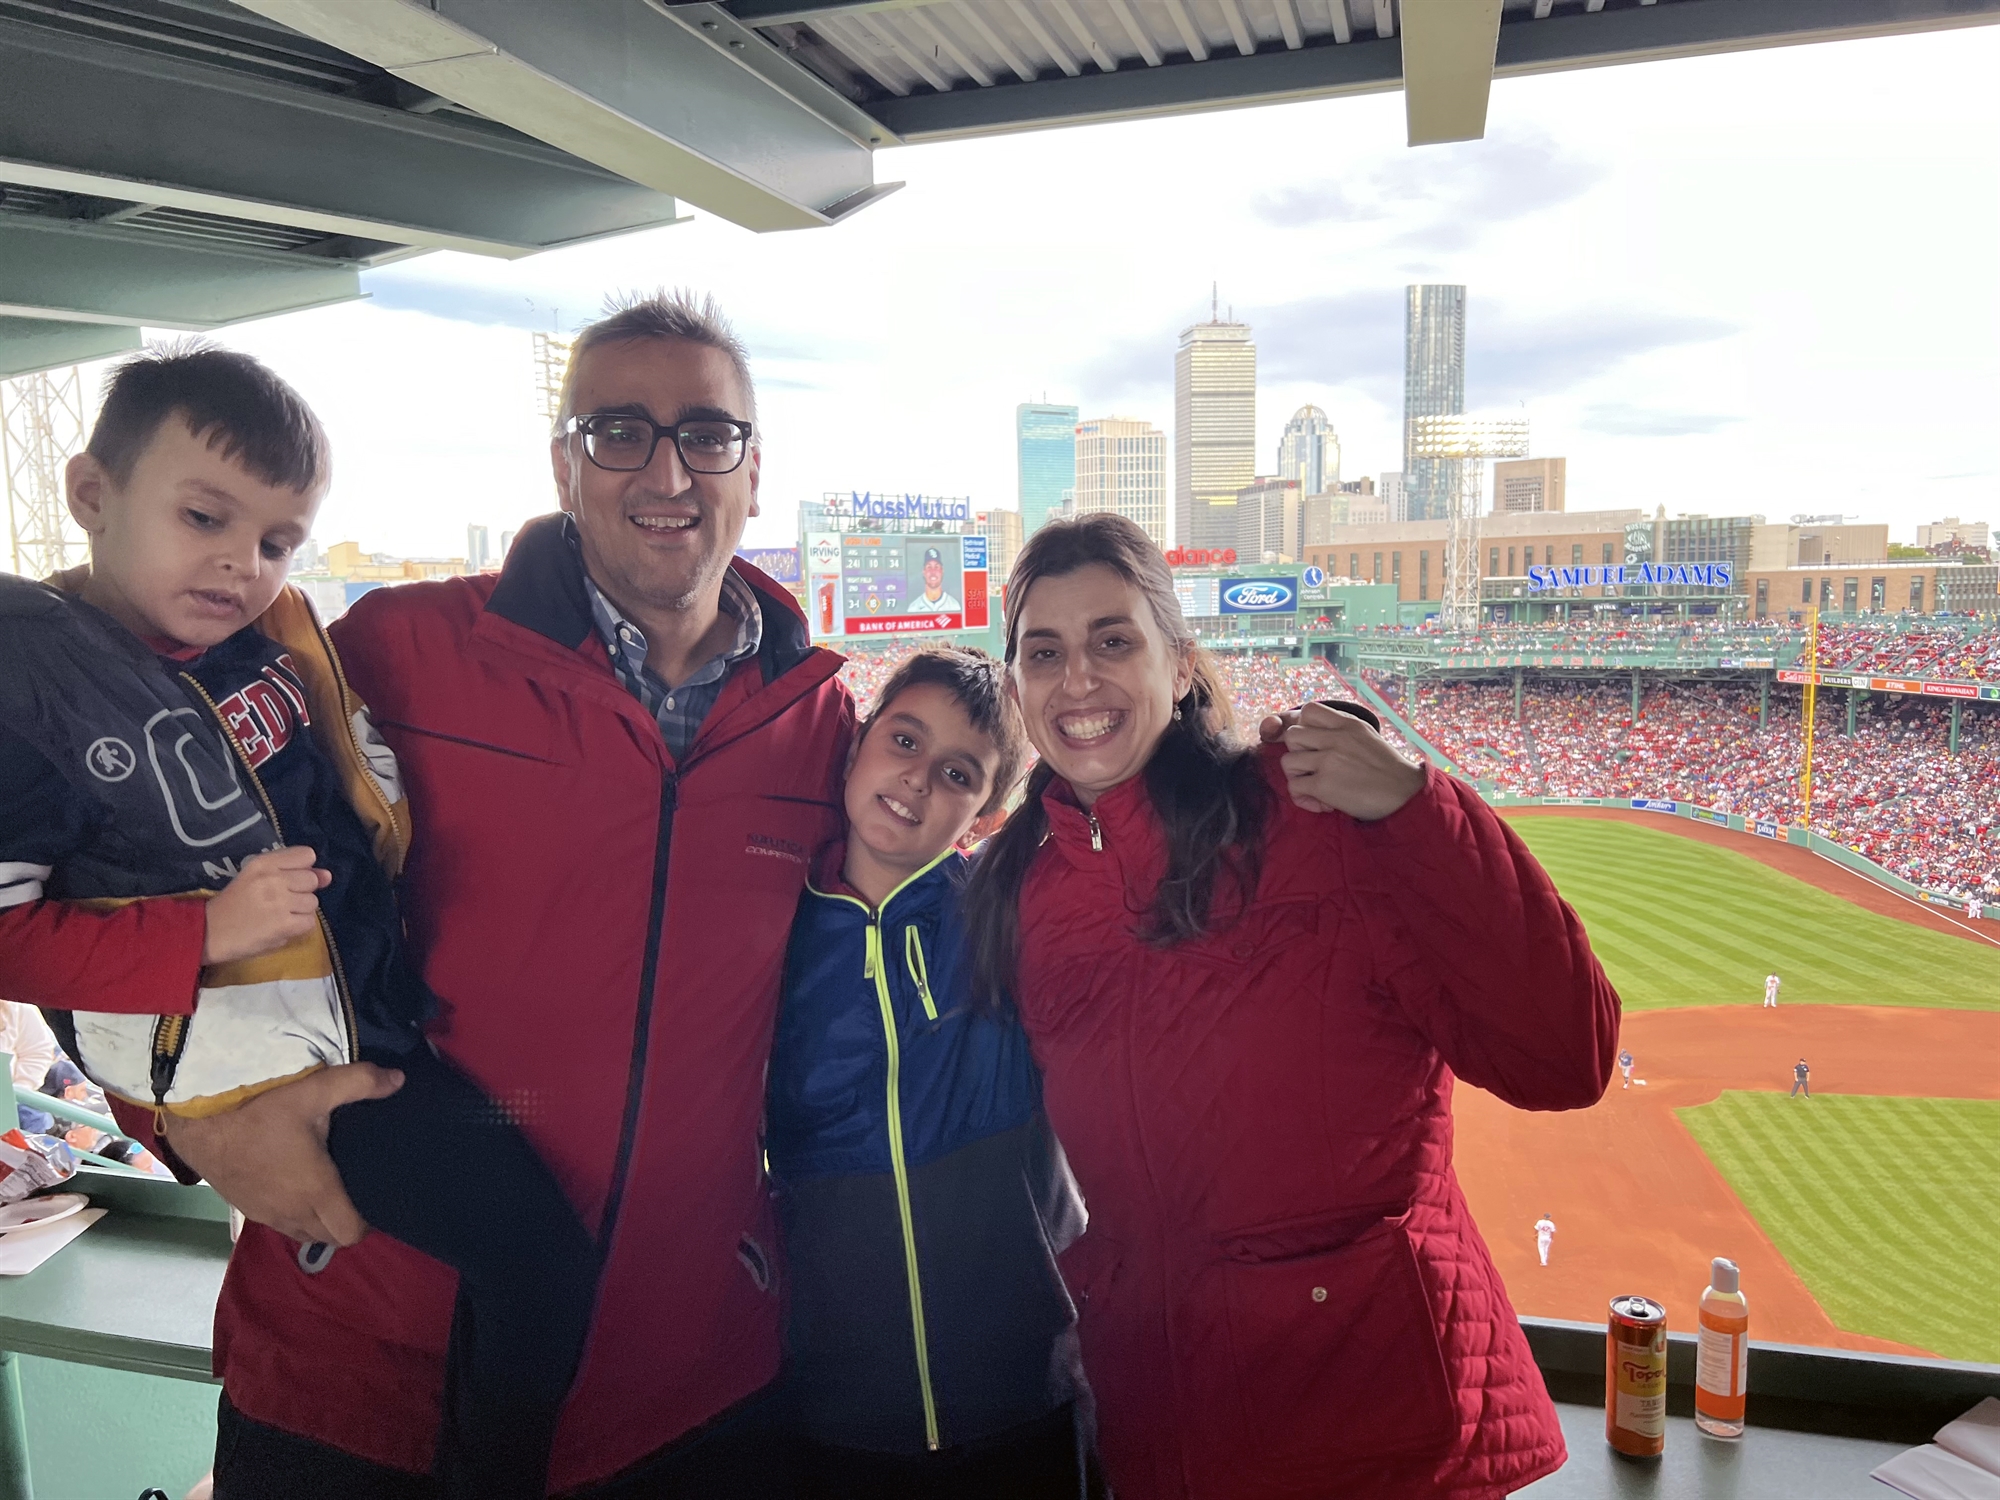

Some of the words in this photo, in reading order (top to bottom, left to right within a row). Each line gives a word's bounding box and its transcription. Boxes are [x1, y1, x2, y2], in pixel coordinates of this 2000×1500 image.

[852, 490, 970, 520] MassMutual
[809, 547, 840, 557] IRVING
[1164, 545, 1237, 567] alance
[869, 559, 879, 568] 10
[889, 559, 899, 568] 34
[1528, 564, 1631, 592] SAMUEL
[1634, 561, 1730, 588] ADAMS
[1237, 586, 1278, 605] Ford
[859, 622, 884, 632] BANK
[884, 621, 896, 631] OF
[897, 619, 935, 630] AMERICA
[1798, 673, 1815, 685] PIZZ
[1824, 676, 1852, 685] BUILDERS
[1853, 678, 1866, 687] GIN
[1885, 681, 1906, 690] STIHL
[1945, 686, 1976, 696] HAWAIIAN
[1493, 792, 1505, 800] 380
[744, 845, 803, 864] COMPETITION
[1622, 1361, 1662, 1383] Topo
